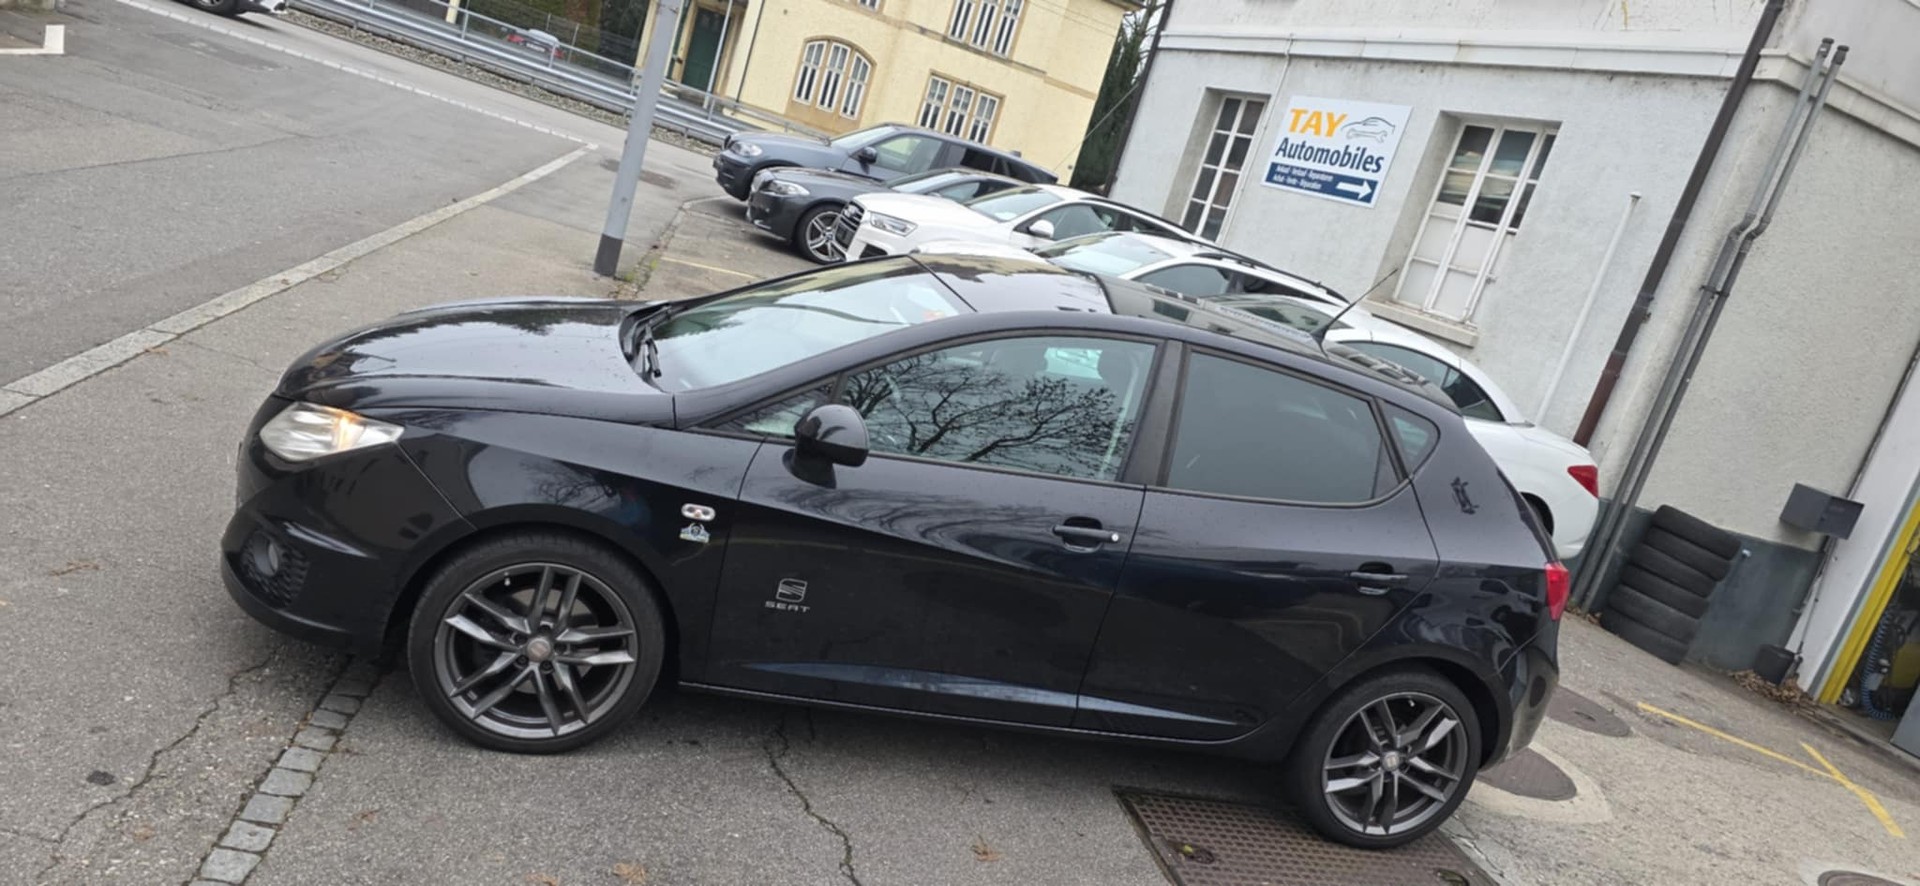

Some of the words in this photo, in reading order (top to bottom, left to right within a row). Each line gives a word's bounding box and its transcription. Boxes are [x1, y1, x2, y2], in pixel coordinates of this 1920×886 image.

[1288, 108, 1347, 137] TAY
[1275, 137, 1384, 173] Automobiles
[765, 600, 810, 613] SEAT
